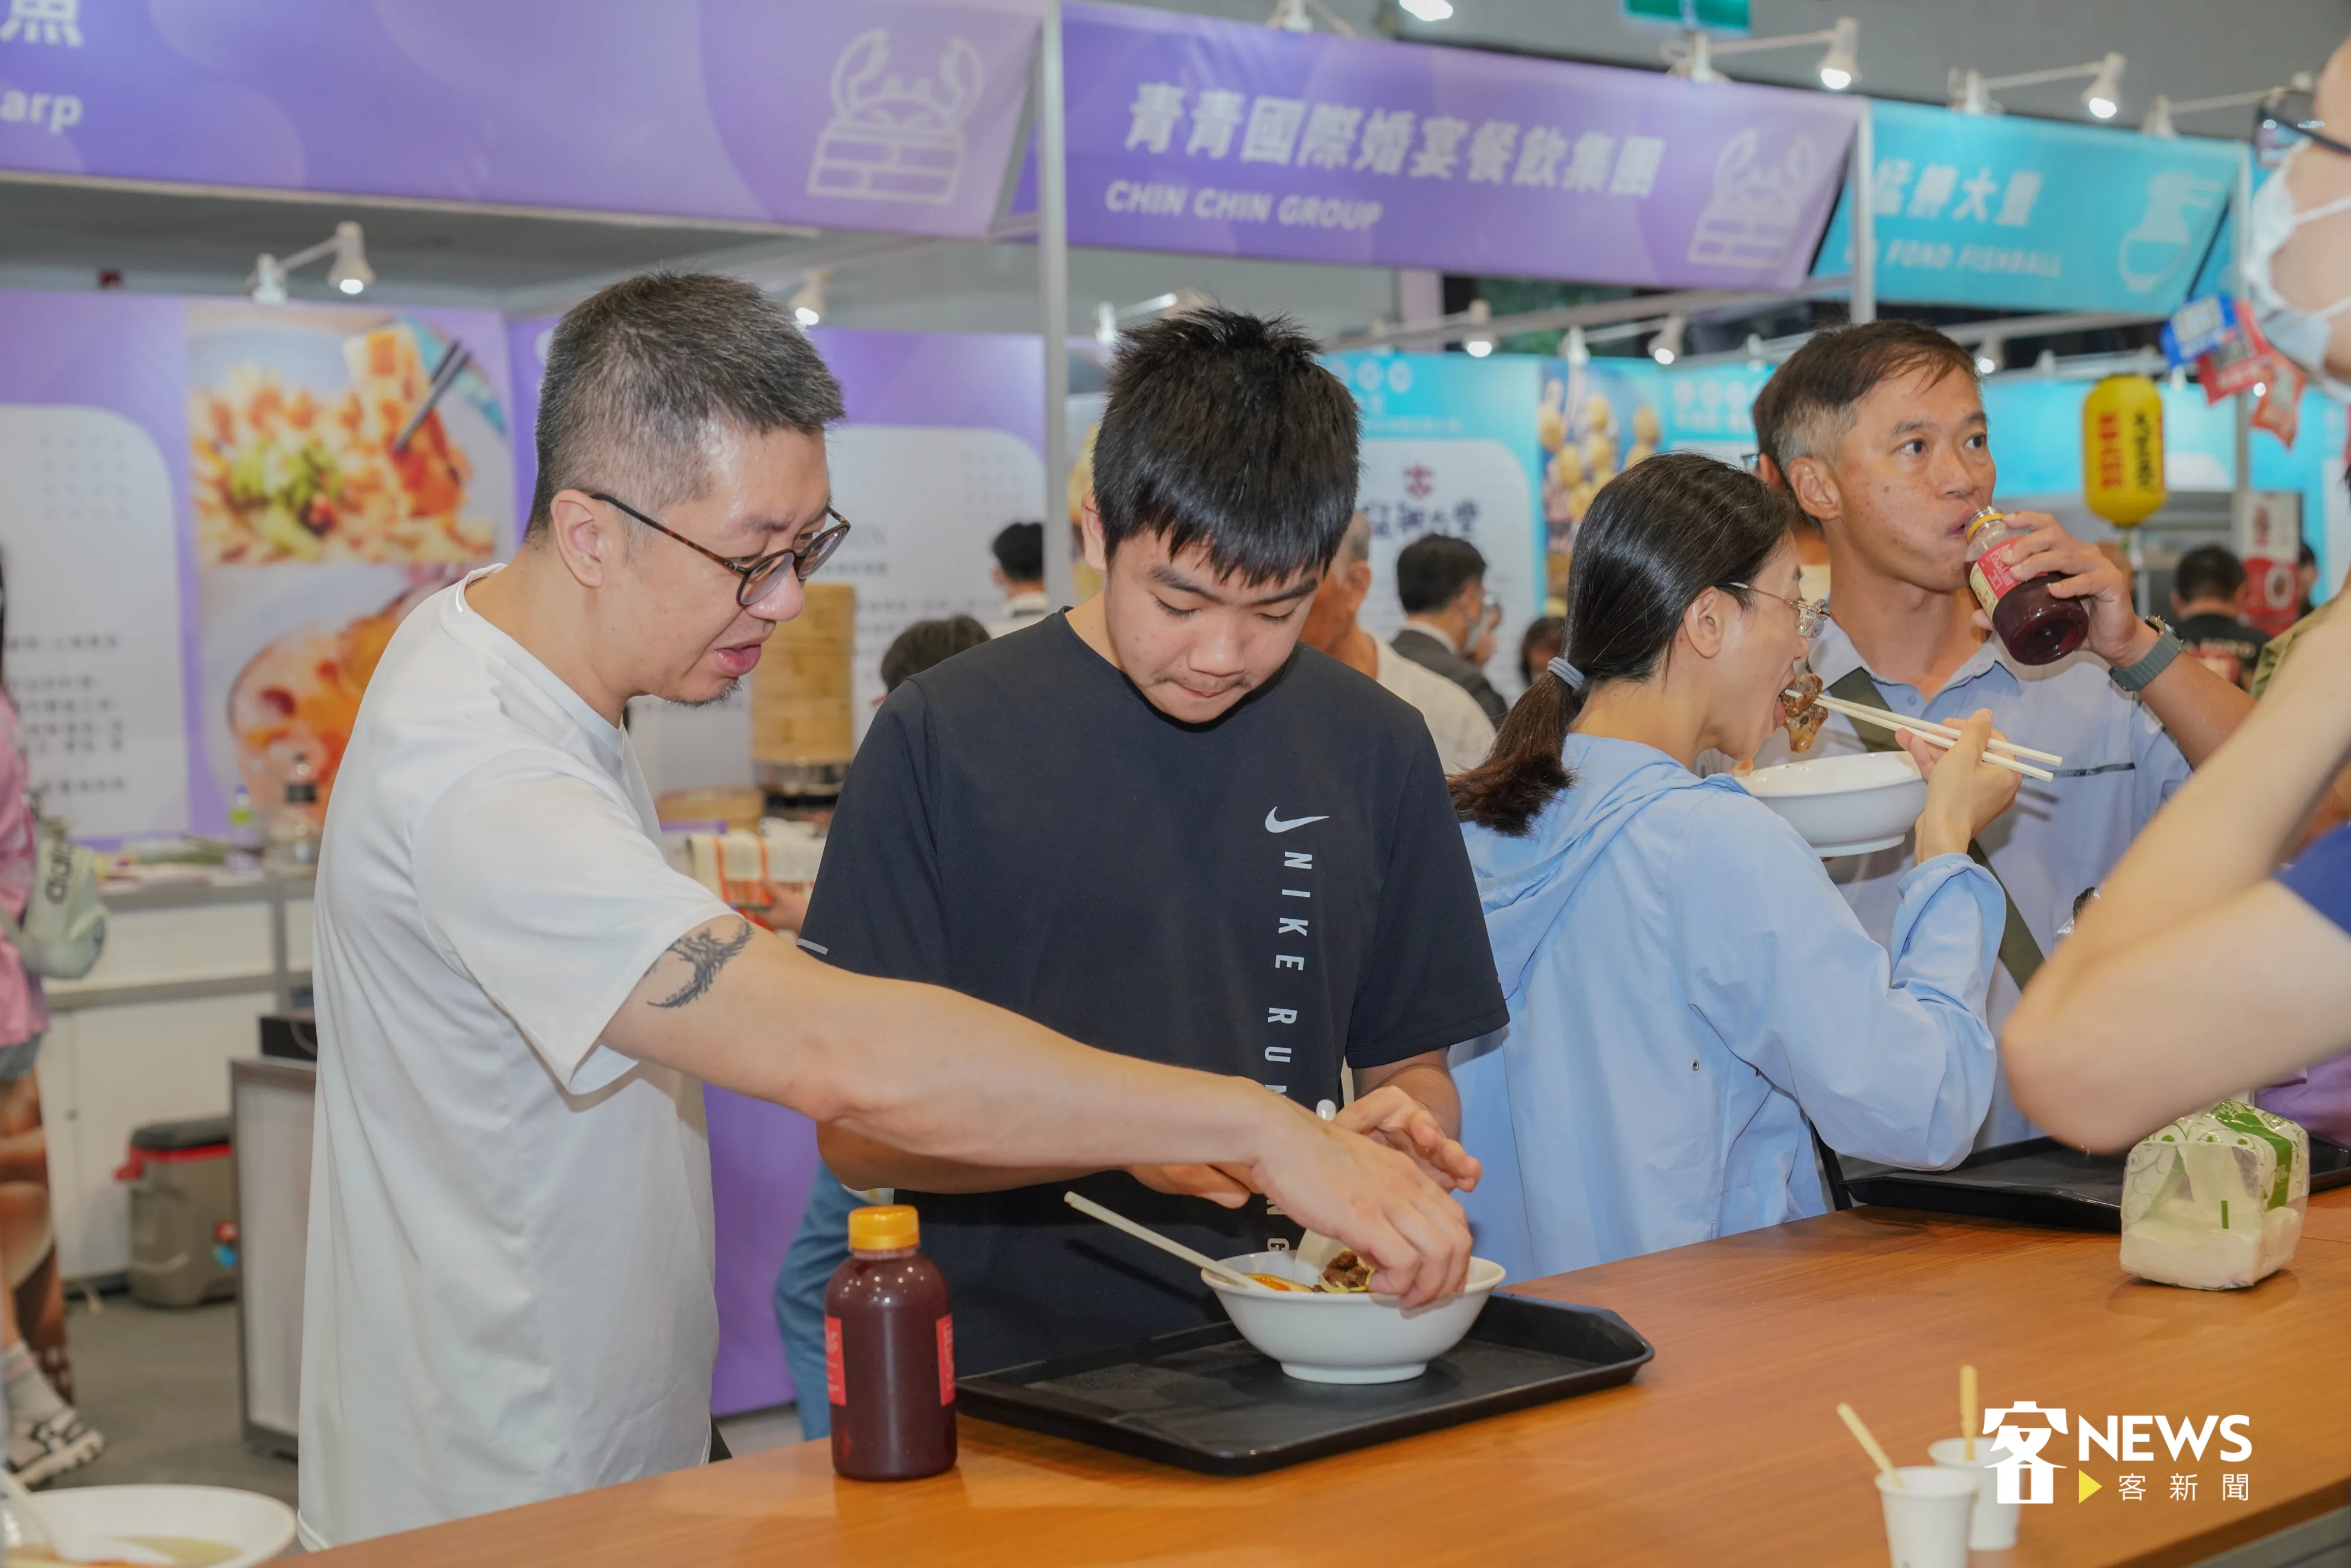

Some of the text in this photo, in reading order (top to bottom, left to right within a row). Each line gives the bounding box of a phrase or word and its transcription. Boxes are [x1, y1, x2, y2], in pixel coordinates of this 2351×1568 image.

[1105, 180, 1384, 230] CHIN CHIN GROUP
[1275, 852, 1312, 970] NIKE
